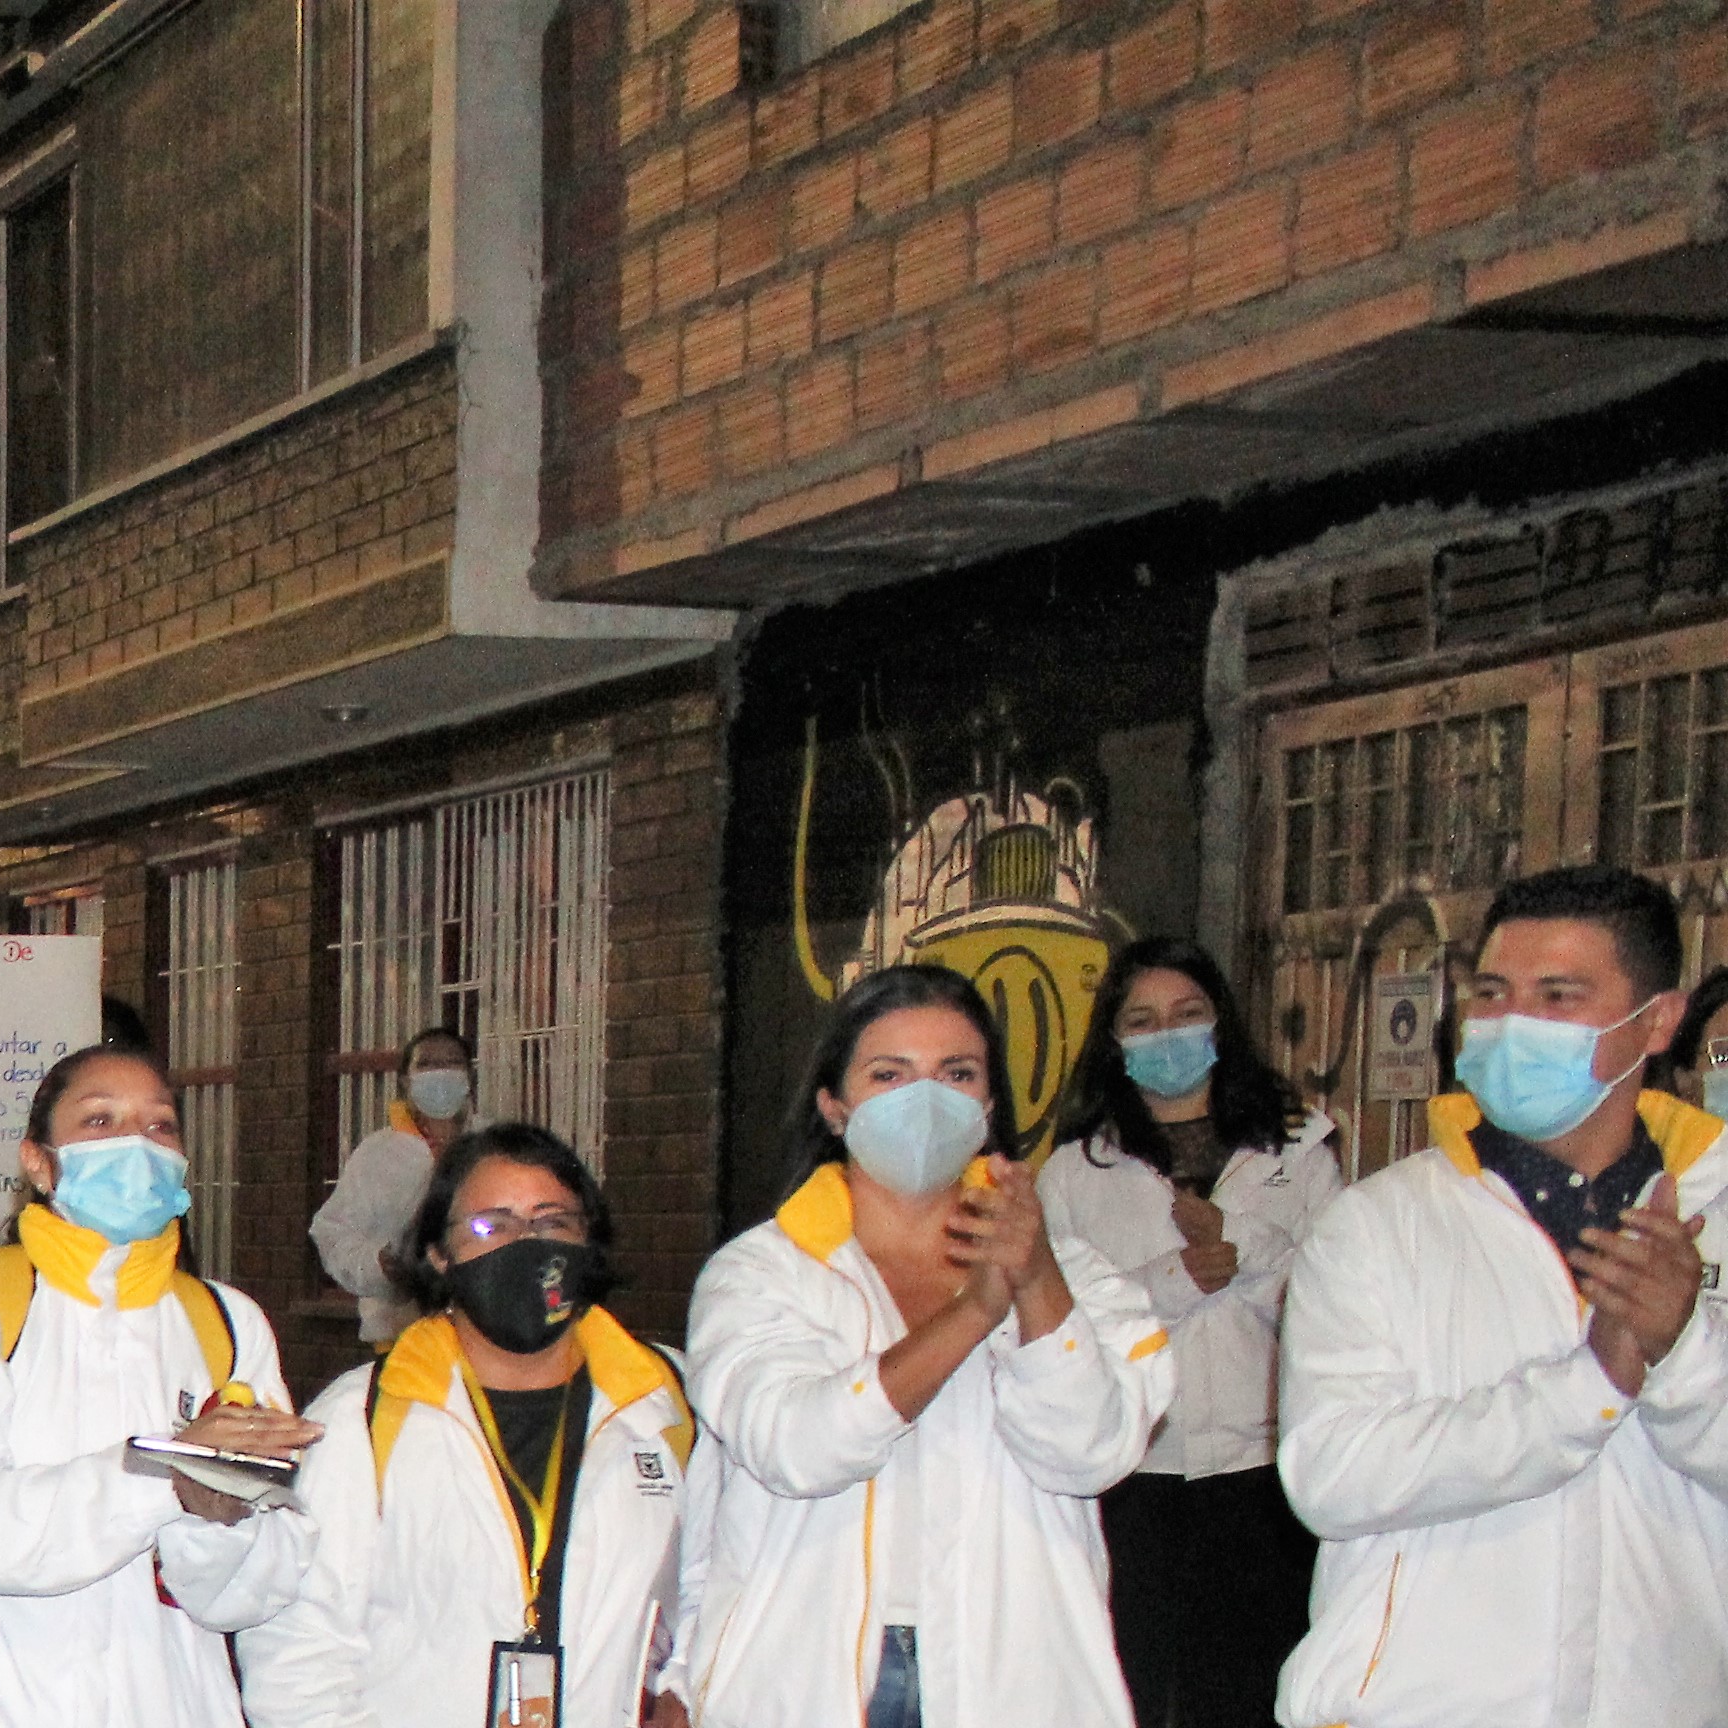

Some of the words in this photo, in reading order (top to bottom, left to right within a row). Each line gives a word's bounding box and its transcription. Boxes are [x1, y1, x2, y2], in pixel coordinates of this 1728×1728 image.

[3, 940, 35, 962] De
[53, 1041, 69, 1057] a
[2, 1060, 45, 1083] desd
